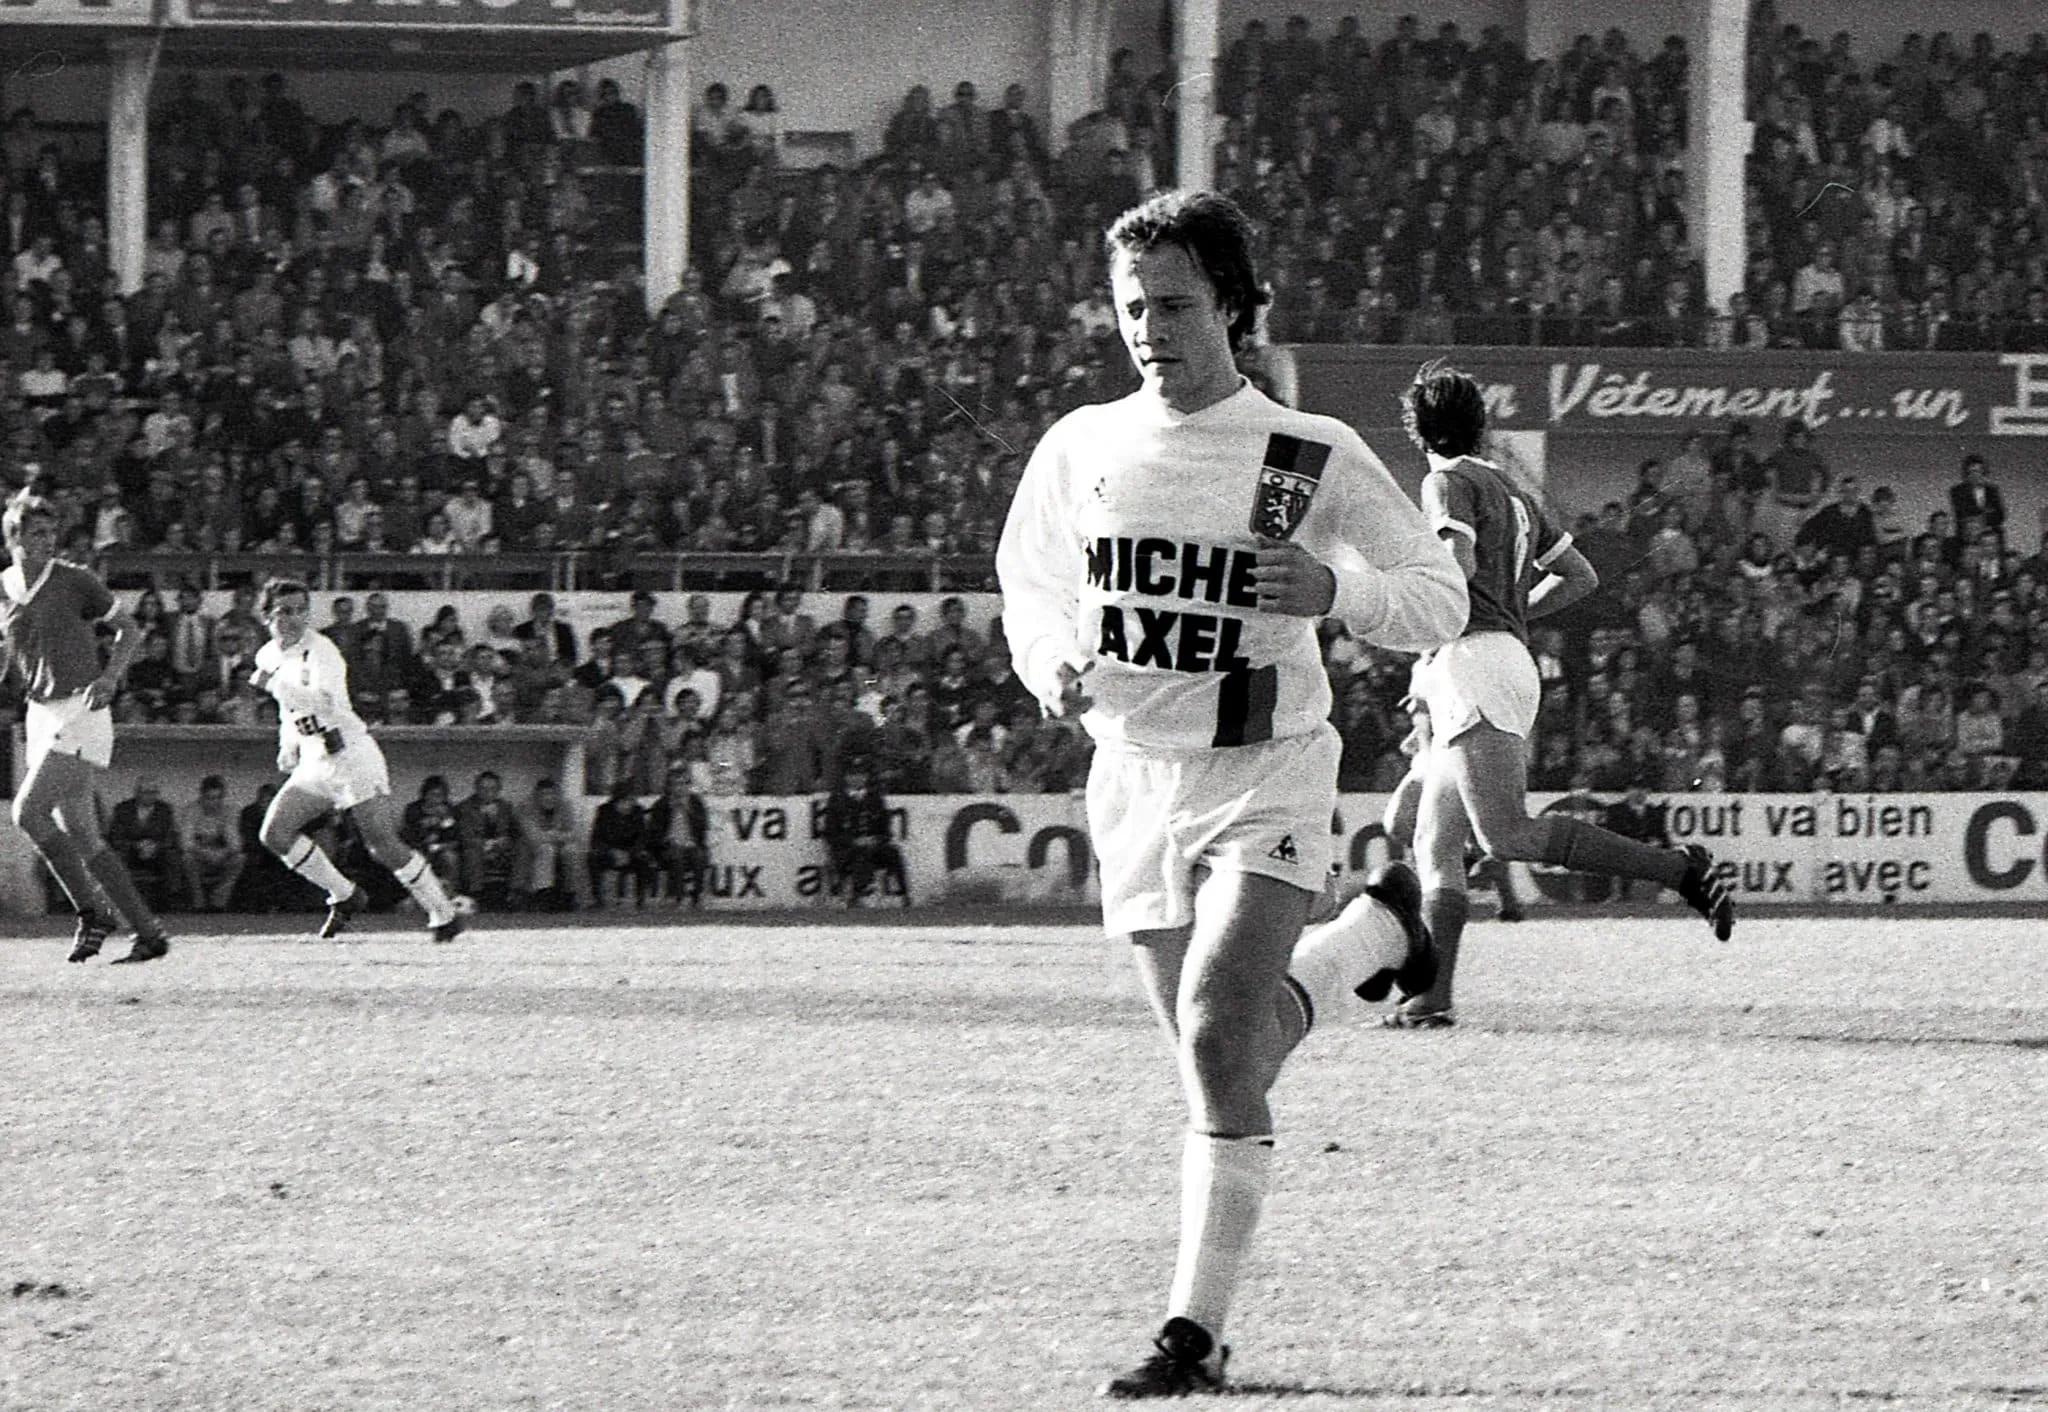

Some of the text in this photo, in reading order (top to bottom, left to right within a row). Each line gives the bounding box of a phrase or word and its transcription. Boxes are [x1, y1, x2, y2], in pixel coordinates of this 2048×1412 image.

[1086, 537, 1258, 608] MICHE
[1098, 605, 1250, 673] AXEL
[731, 806, 787, 841] va
[1765, 805, 1815, 837] va
[1838, 799, 1932, 837] bien
[1825, 860, 1930, 893] avec
